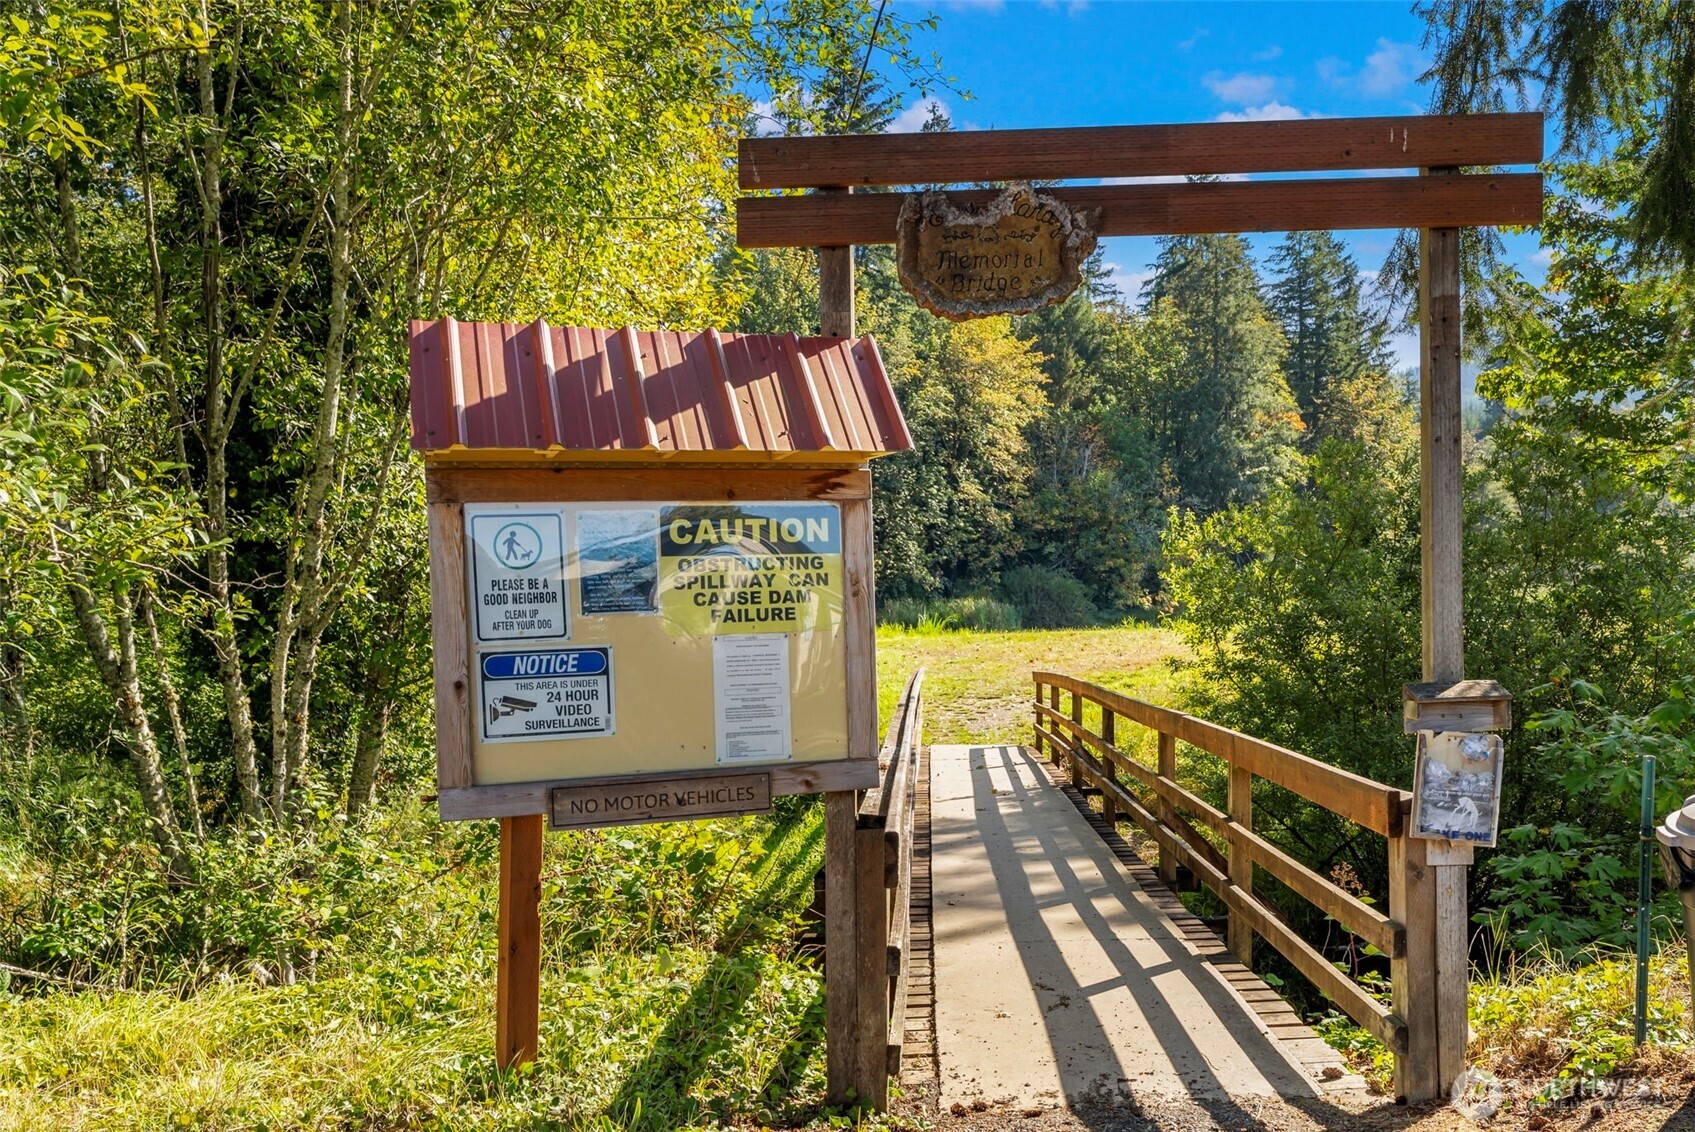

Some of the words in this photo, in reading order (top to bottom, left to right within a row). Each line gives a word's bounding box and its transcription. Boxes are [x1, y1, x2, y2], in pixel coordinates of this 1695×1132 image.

[936, 249, 1044, 269] Memorial
[950, 273, 1023, 295] Bridge
[669, 518, 829, 545] CAUTION
[677, 555, 824, 572] OBSTRUCTING
[491, 578, 525, 591] PLEASE
[528, 578, 539, 590] BE
[542, 578, 549, 589] A
[673, 573, 776, 591] SPILLWAY
[788, 572, 829, 587] CAN
[483, 593, 508, 606] GOOD
[512, 591, 558, 605] NEIGHBOR
[693, 591, 762, 607] CAUSE
[769, 589, 812, 605] DAM
[504, 610, 527, 620] CLEAN
[529, 609, 539, 619] UP
[711, 607, 796, 623] FAILURE
[492, 621, 515, 631] AFTER
[516, 620, 536, 630] YOUR
[538, 619, 552, 629] DOG
[513, 654, 580, 675] NOTICE
[515, 682, 534, 691] THIS
[536, 681, 558, 690] AREA
[560, 680, 568, 688] IS
[570, 679, 599, 688] UNDER
[546, 691, 562, 703] 24
[566, 689, 599, 702] HOUR
[555, 703, 592, 716] VIDEO
[525, 717, 600, 731] SURVEILLANCE
[571, 799, 598, 815] NO
[604, 793, 670, 812] MOTOR
[674, 786, 755, 807] VEHICLES
[1465, 831, 1492, 842] ONE
